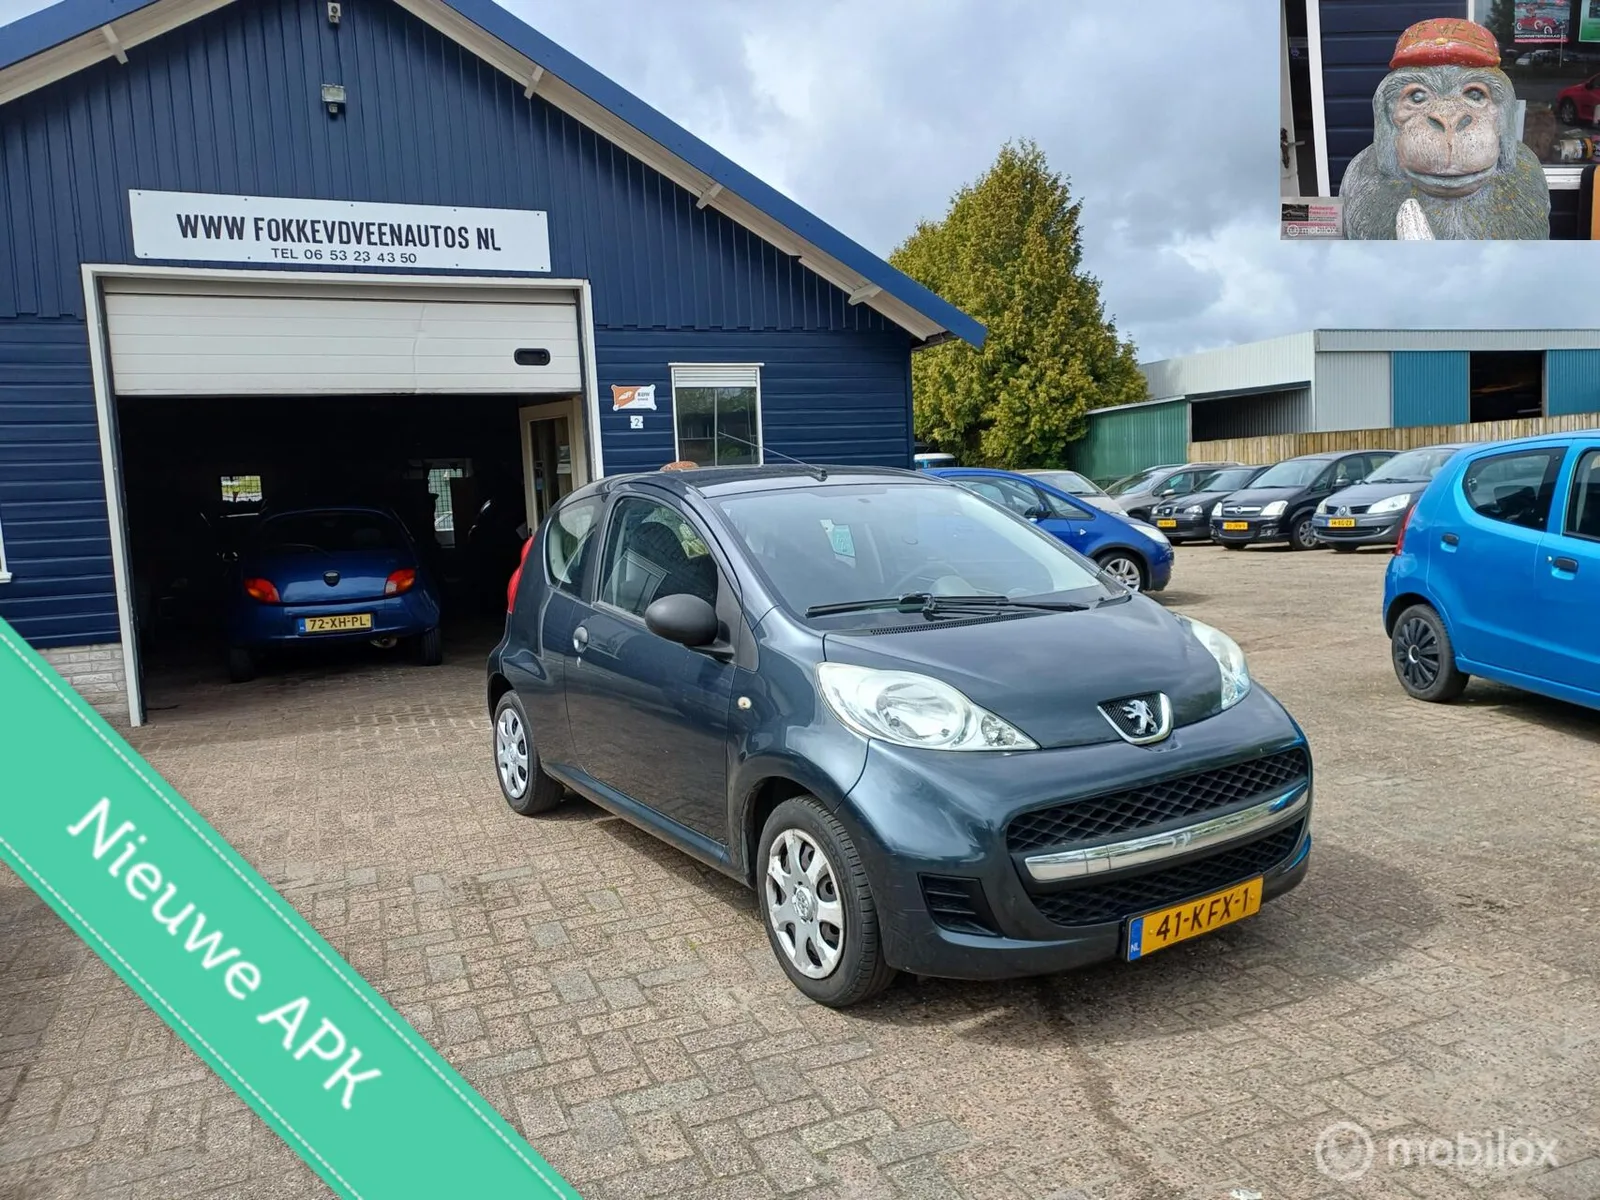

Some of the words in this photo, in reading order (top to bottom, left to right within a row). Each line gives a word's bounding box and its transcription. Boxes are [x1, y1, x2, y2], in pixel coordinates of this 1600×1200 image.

[176, 213, 246, 241] WWW
[253, 217, 470, 250] FOKKEVDVEENAUTOS
[476, 227, 502, 251] NL
[271, 247, 299, 260] TEL
[304, 249, 323, 260] 06
[330, 250, 348, 261] 53
[353, 251, 371, 263] 23
[377, 253, 396, 263] 43
[400, 253, 417, 264] 50
[634, 417, 640, 427] 2
[309, 617, 367, 630] 72-XH-PL
[1156, 888, 1249, 941] 41-KFX-1
[1130, 943, 1140, 953] NL
